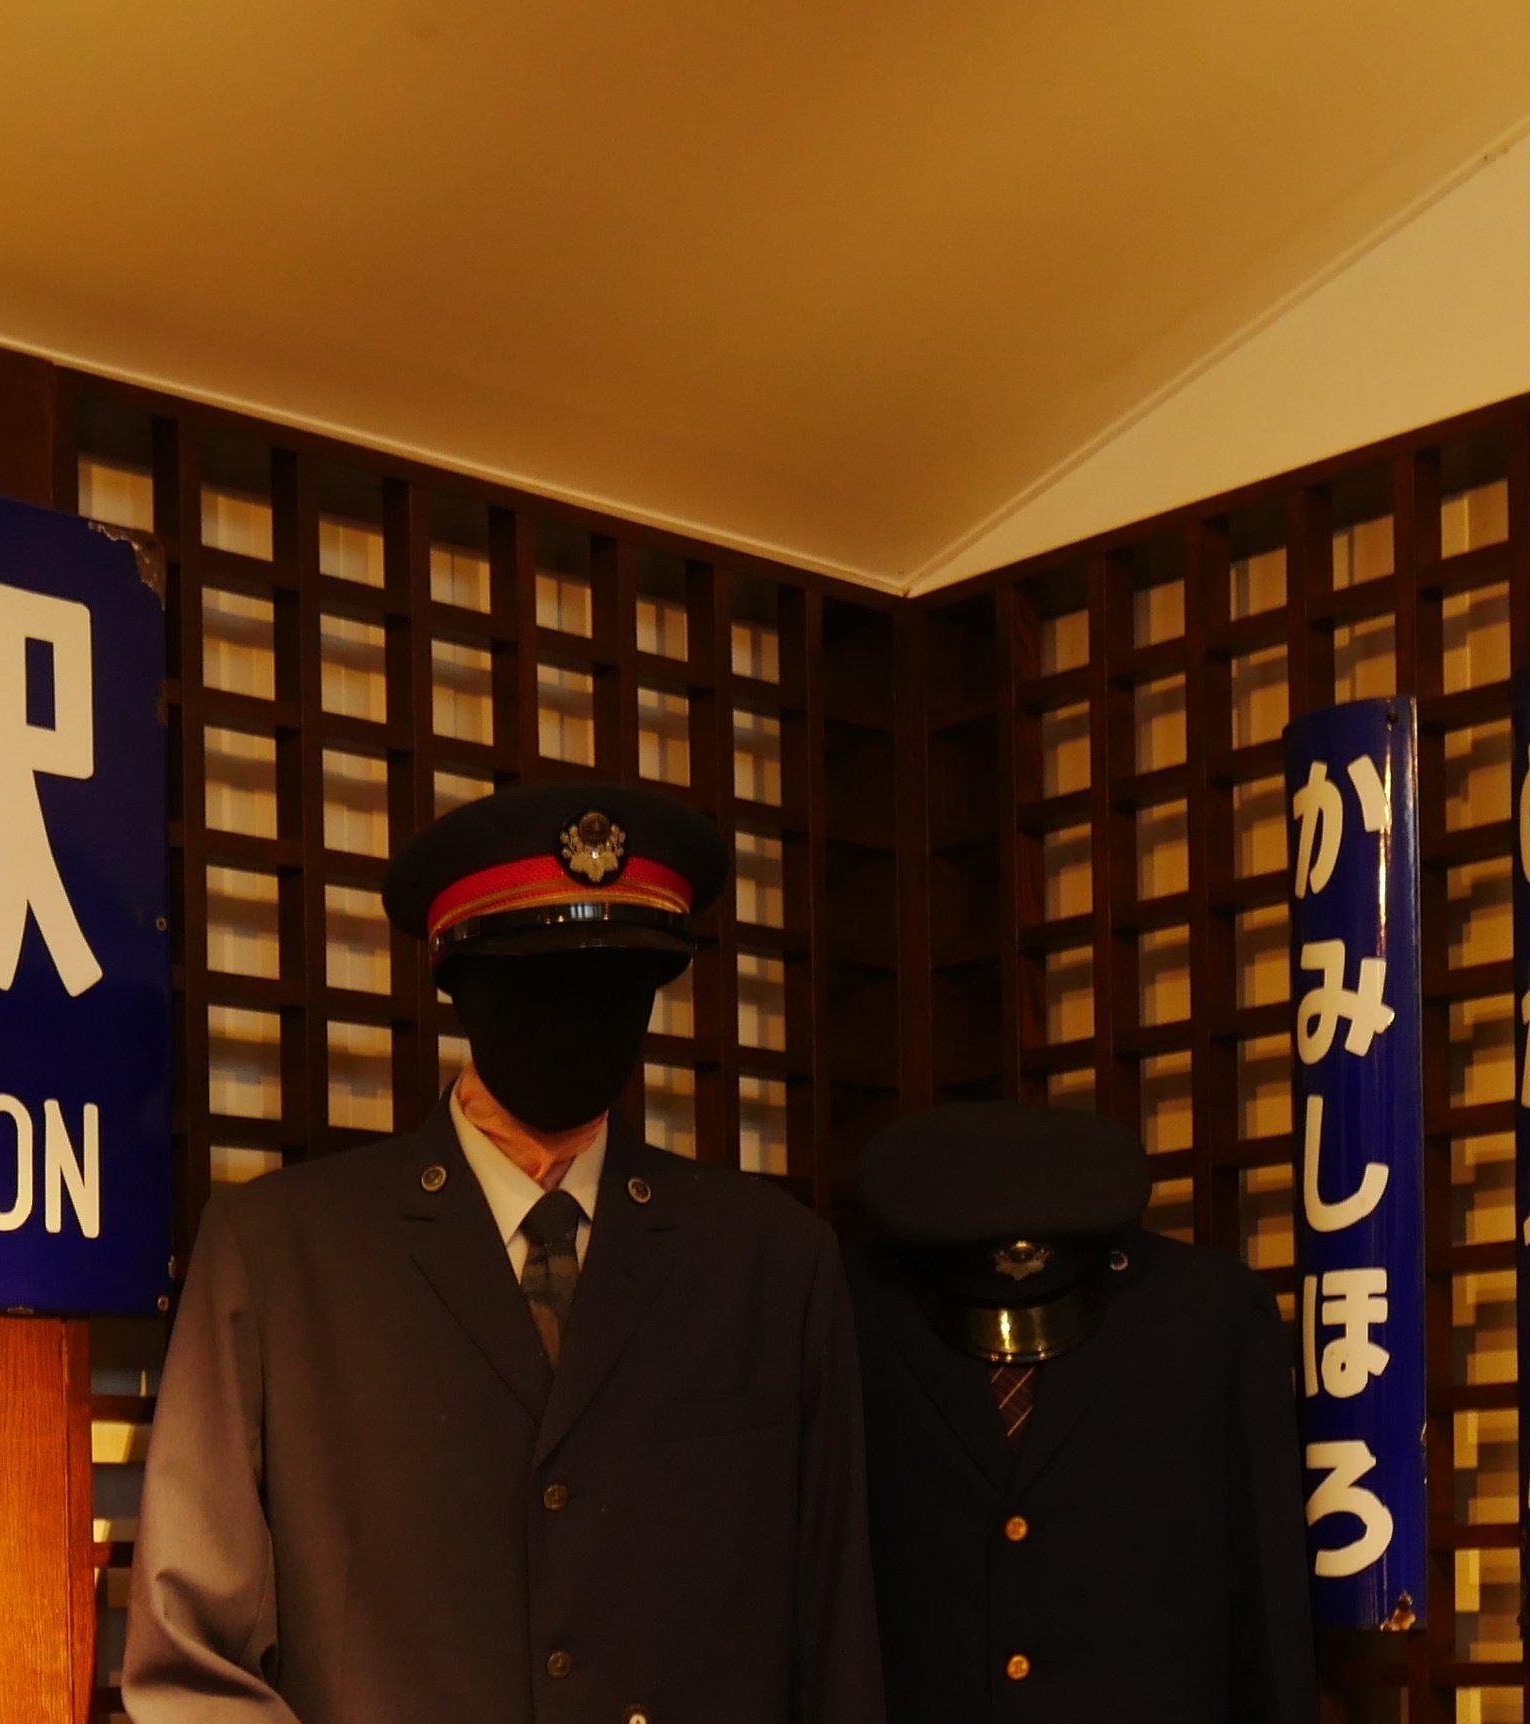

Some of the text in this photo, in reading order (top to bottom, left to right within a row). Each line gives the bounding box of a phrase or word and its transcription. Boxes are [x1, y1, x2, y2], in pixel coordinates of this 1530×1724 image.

[1294, 755, 1395, 1578] かみしほろ
